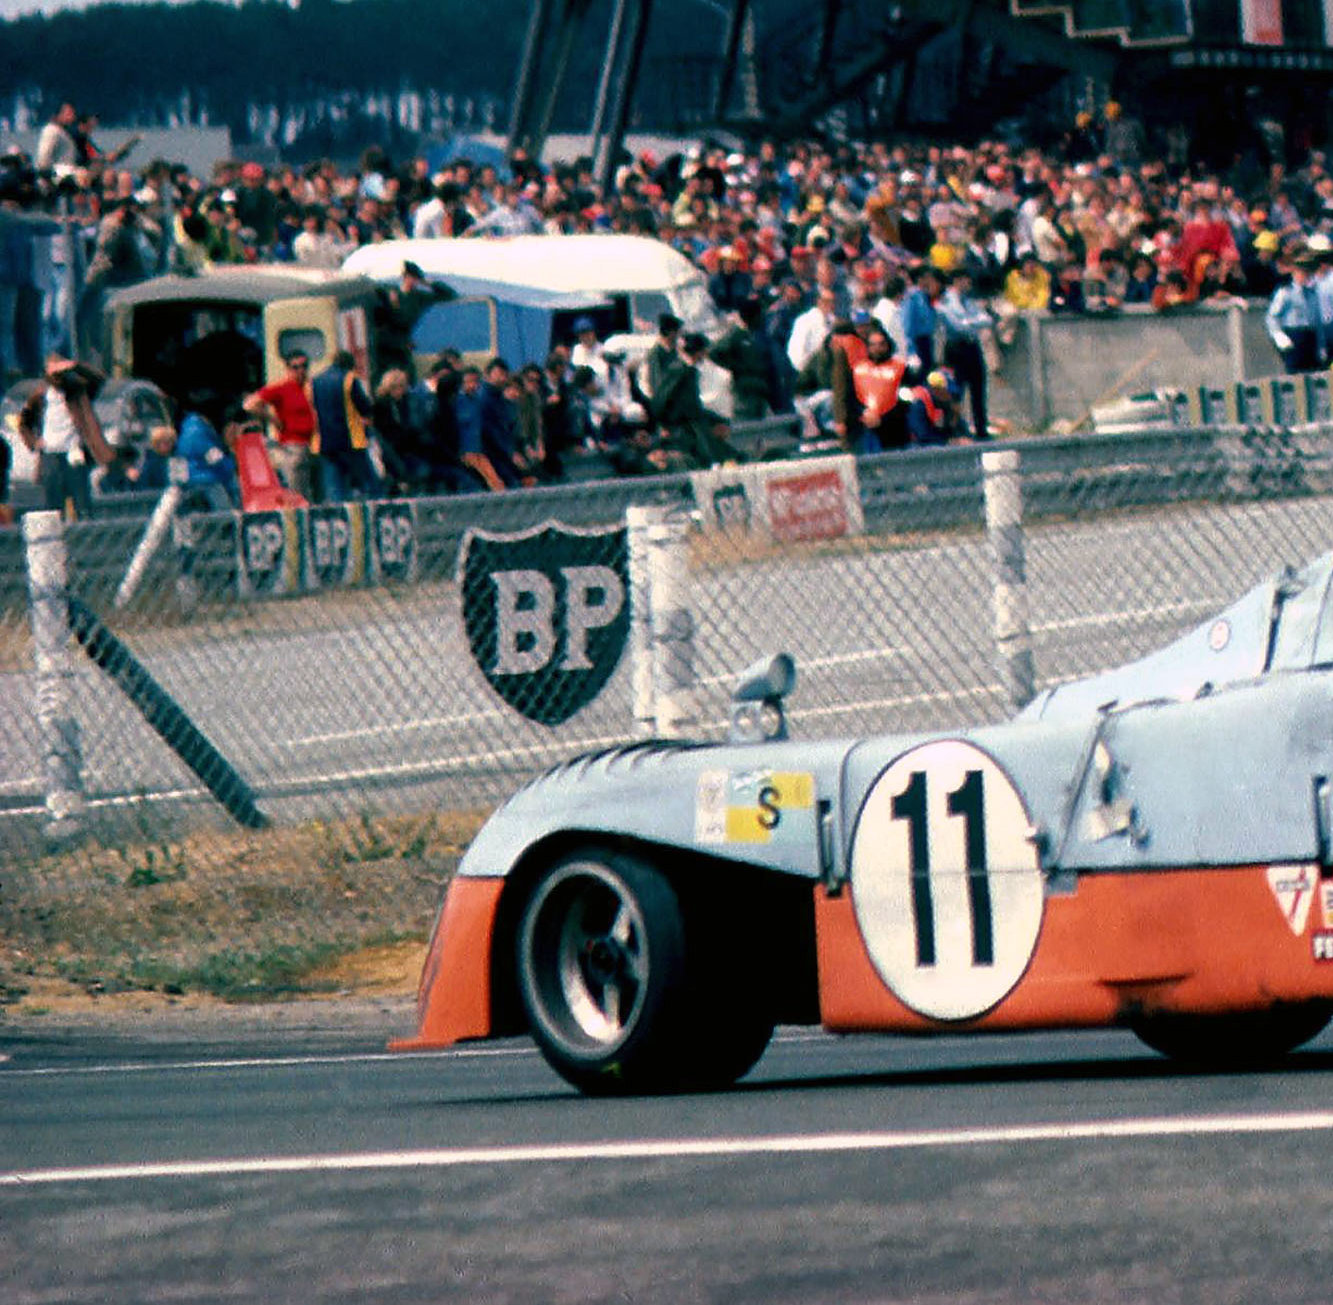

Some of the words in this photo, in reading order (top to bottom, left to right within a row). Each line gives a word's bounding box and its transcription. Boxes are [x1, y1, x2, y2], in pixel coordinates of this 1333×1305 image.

[247, 522, 283, 570] BP
[314, 519, 348, 566] BP
[379, 516, 412, 563] BP
[491, 564, 627, 675] BP
[758, 786, 781, 830] S
[891, 770, 994, 968] 11
